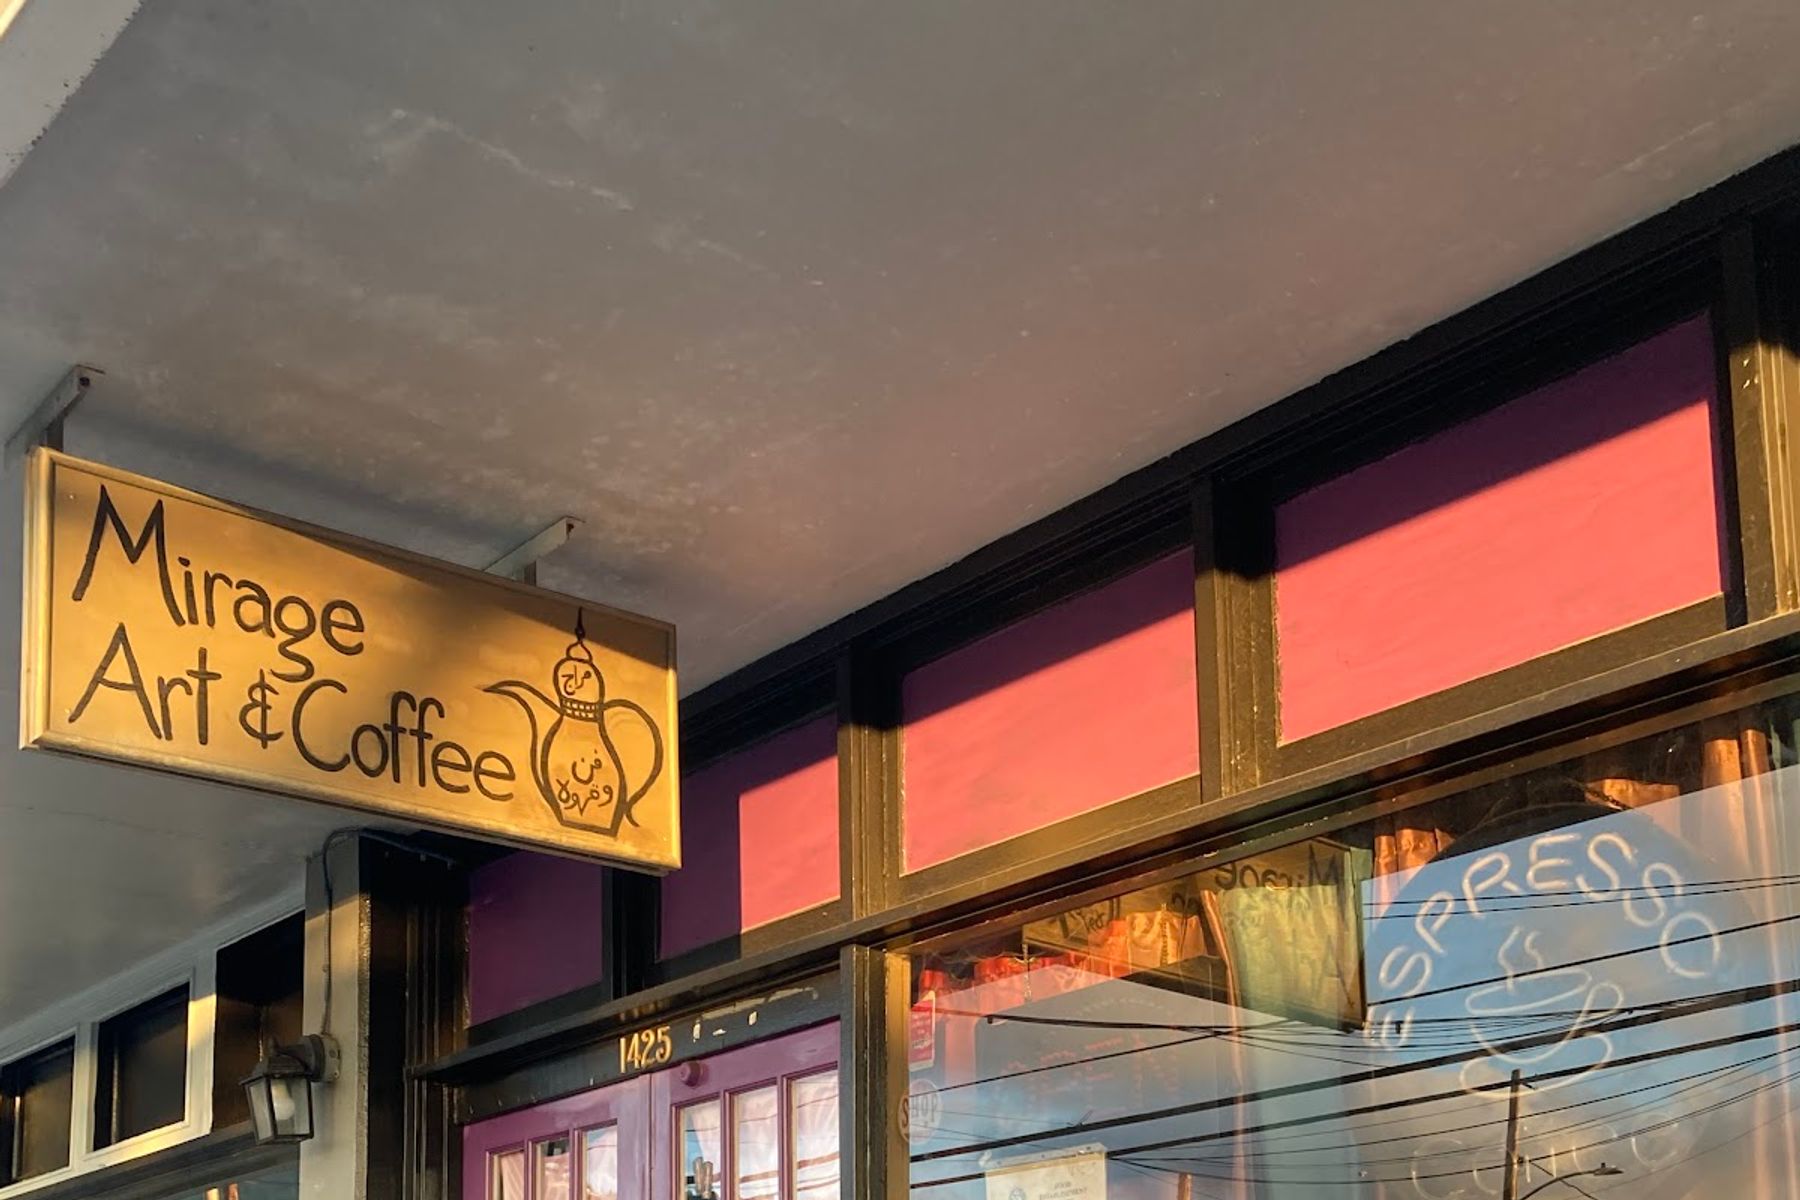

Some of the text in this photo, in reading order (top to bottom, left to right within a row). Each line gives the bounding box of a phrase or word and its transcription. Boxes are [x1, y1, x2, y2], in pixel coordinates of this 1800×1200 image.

[72, 484, 365, 682] Mirage
[68, 622, 516, 802] Art & Coffee
[1364, 832, 1720, 1050] ESPRESSO
[620, 1026, 672, 1074] 1425
